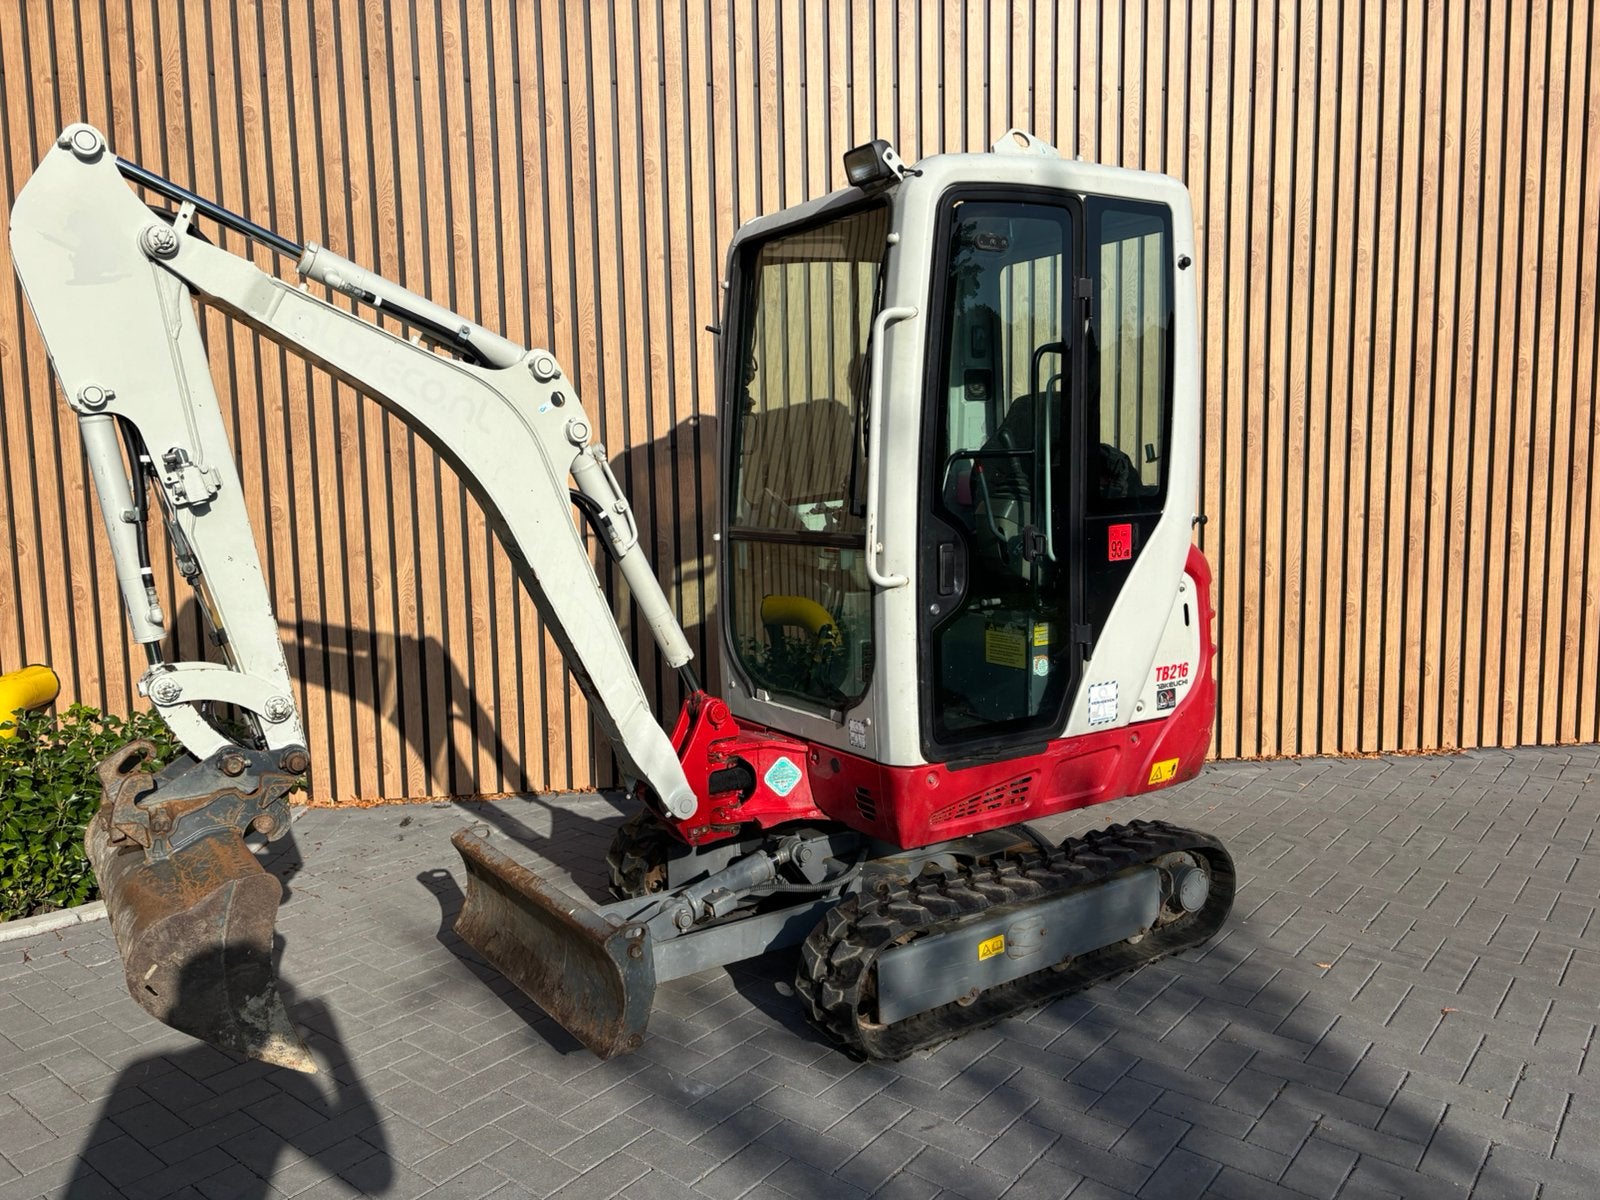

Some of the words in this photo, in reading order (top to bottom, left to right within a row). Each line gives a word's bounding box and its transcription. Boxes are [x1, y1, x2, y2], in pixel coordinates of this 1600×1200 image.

[1111, 540, 1122, 557] 93
[1155, 662, 1189, 682] TB216
[1156, 679, 1188, 689] TAKEUCHI
